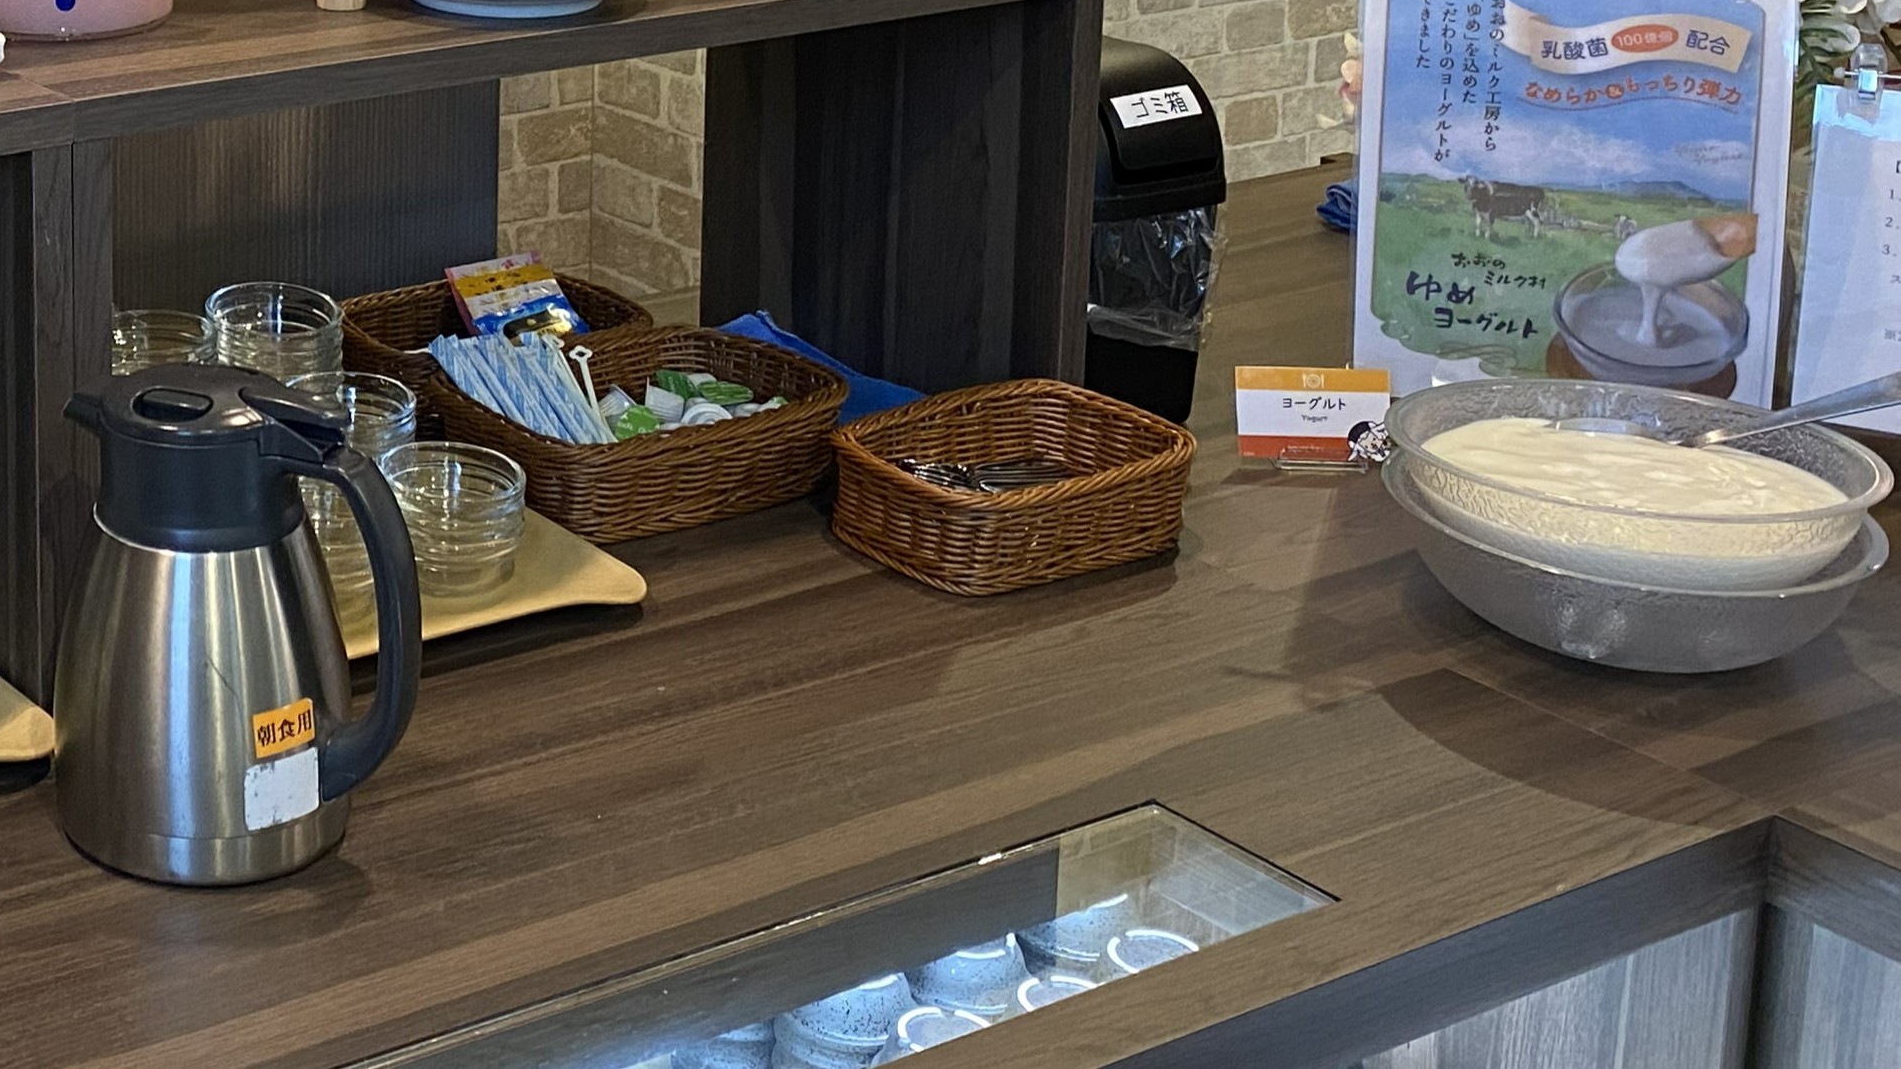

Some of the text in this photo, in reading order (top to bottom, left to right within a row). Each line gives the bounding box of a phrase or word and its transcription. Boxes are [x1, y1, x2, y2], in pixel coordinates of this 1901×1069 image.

[1540, 37, 1609, 60] 乳酸菌
[1685, 29, 1731, 56] 配合
[1131, 91, 1189, 118] ゴミ箱
[1406, 270, 1476, 304] ゆめ
[1434, 307, 1539, 339] ヨーグルト
[1282, 396, 1346, 411] ヨーグルト
[257, 709, 313, 747] 朝食用
